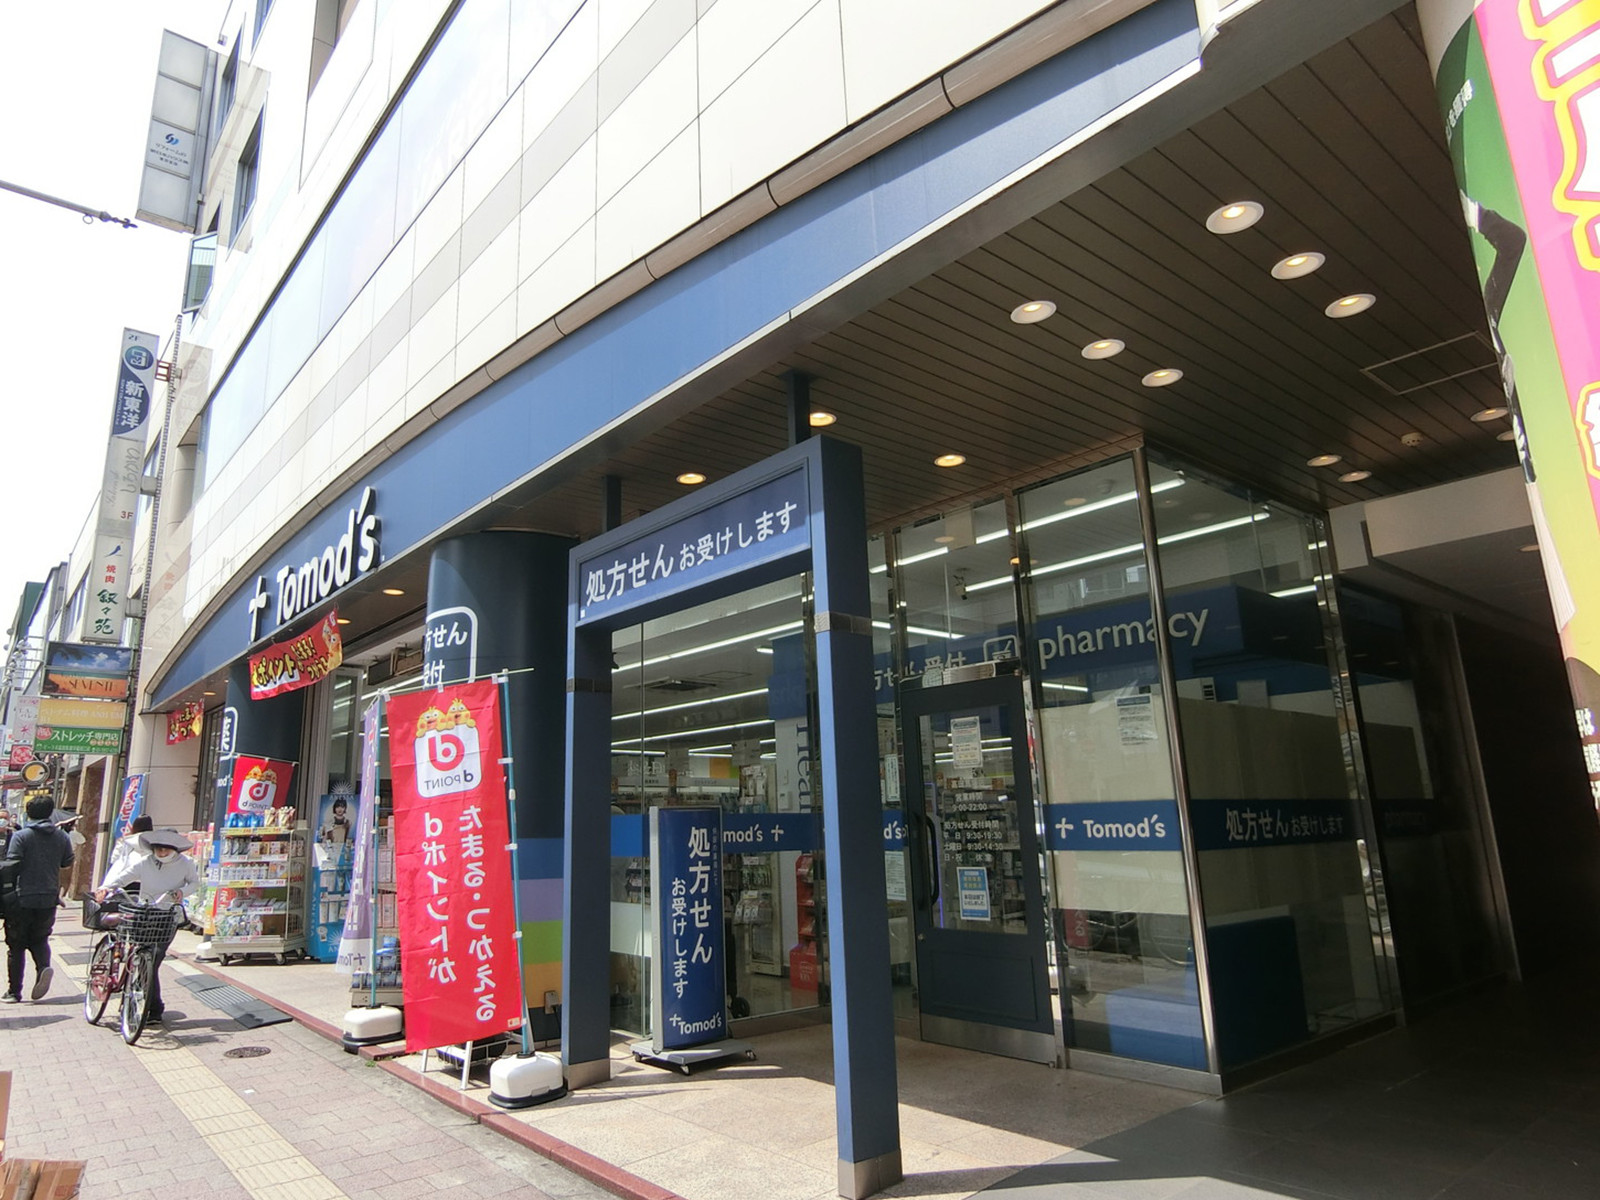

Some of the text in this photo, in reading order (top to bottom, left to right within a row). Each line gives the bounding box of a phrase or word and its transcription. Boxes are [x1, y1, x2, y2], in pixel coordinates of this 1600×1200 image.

[121, 380, 144, 429] 新東洋
[120, 511, 134, 520] 3F
[105, 564, 117, 584] 焼肉
[276, 486, 378, 626] Tomod's
[1038, 608, 1209, 670] pharmacy
[1082, 814, 1166, 839] Tomod's
[688, 826, 713, 965] 処方せん
[671, 876, 689, 999] お受けします
[678, 1010, 722, 1035] Tomod's
